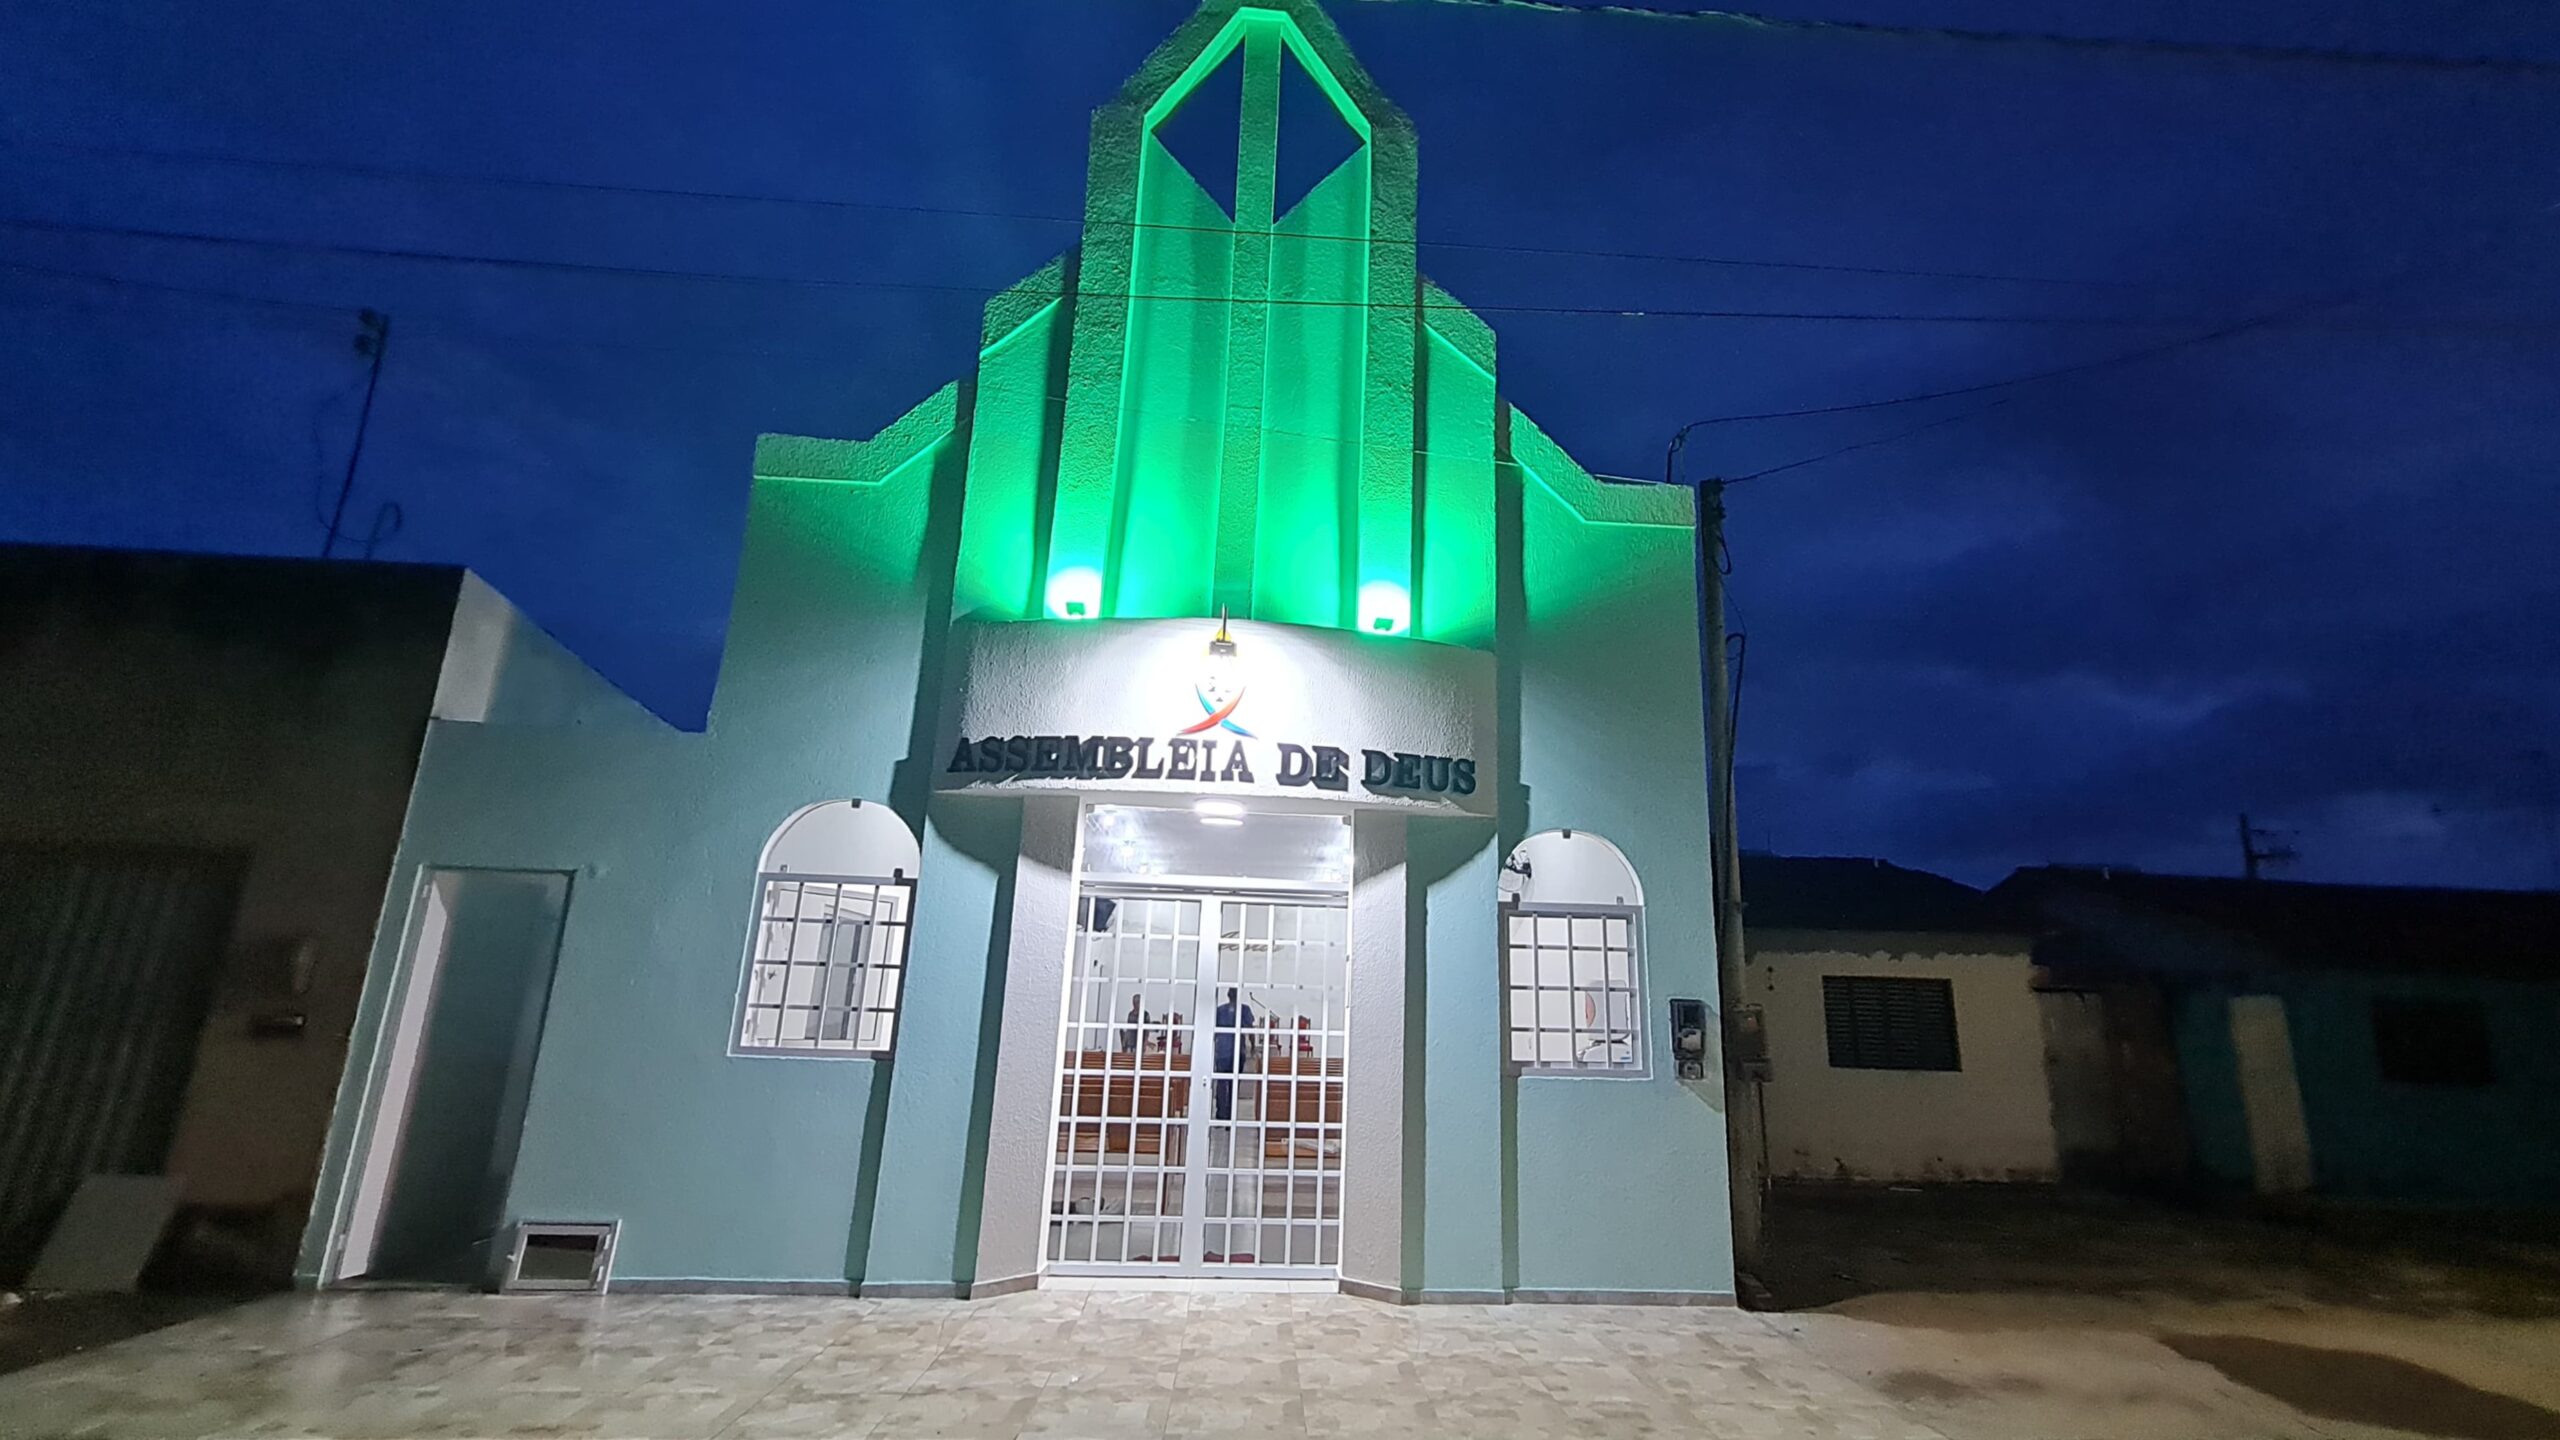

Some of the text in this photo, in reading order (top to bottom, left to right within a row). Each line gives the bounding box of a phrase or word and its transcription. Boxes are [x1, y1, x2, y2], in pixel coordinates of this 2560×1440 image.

[946, 735, 1476, 796] ASSEMBLEIA DE DEUS
